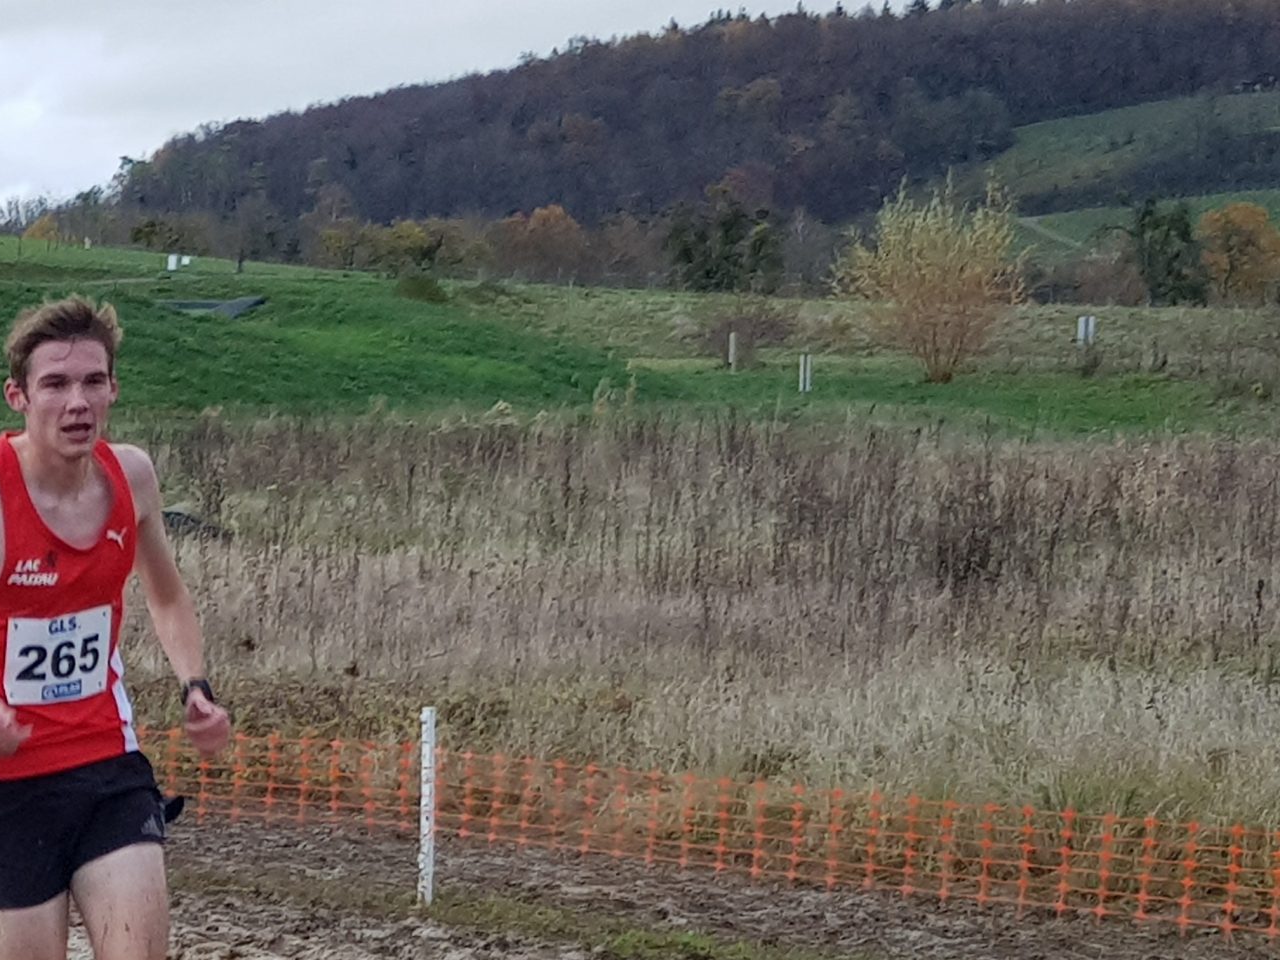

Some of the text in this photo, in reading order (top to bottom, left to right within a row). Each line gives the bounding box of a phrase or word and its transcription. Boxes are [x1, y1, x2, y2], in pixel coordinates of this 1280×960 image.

[15, 558, 41, 573] LAC
[48, 616, 78, 635] GLS
[16, 633, 100, 681] 265
